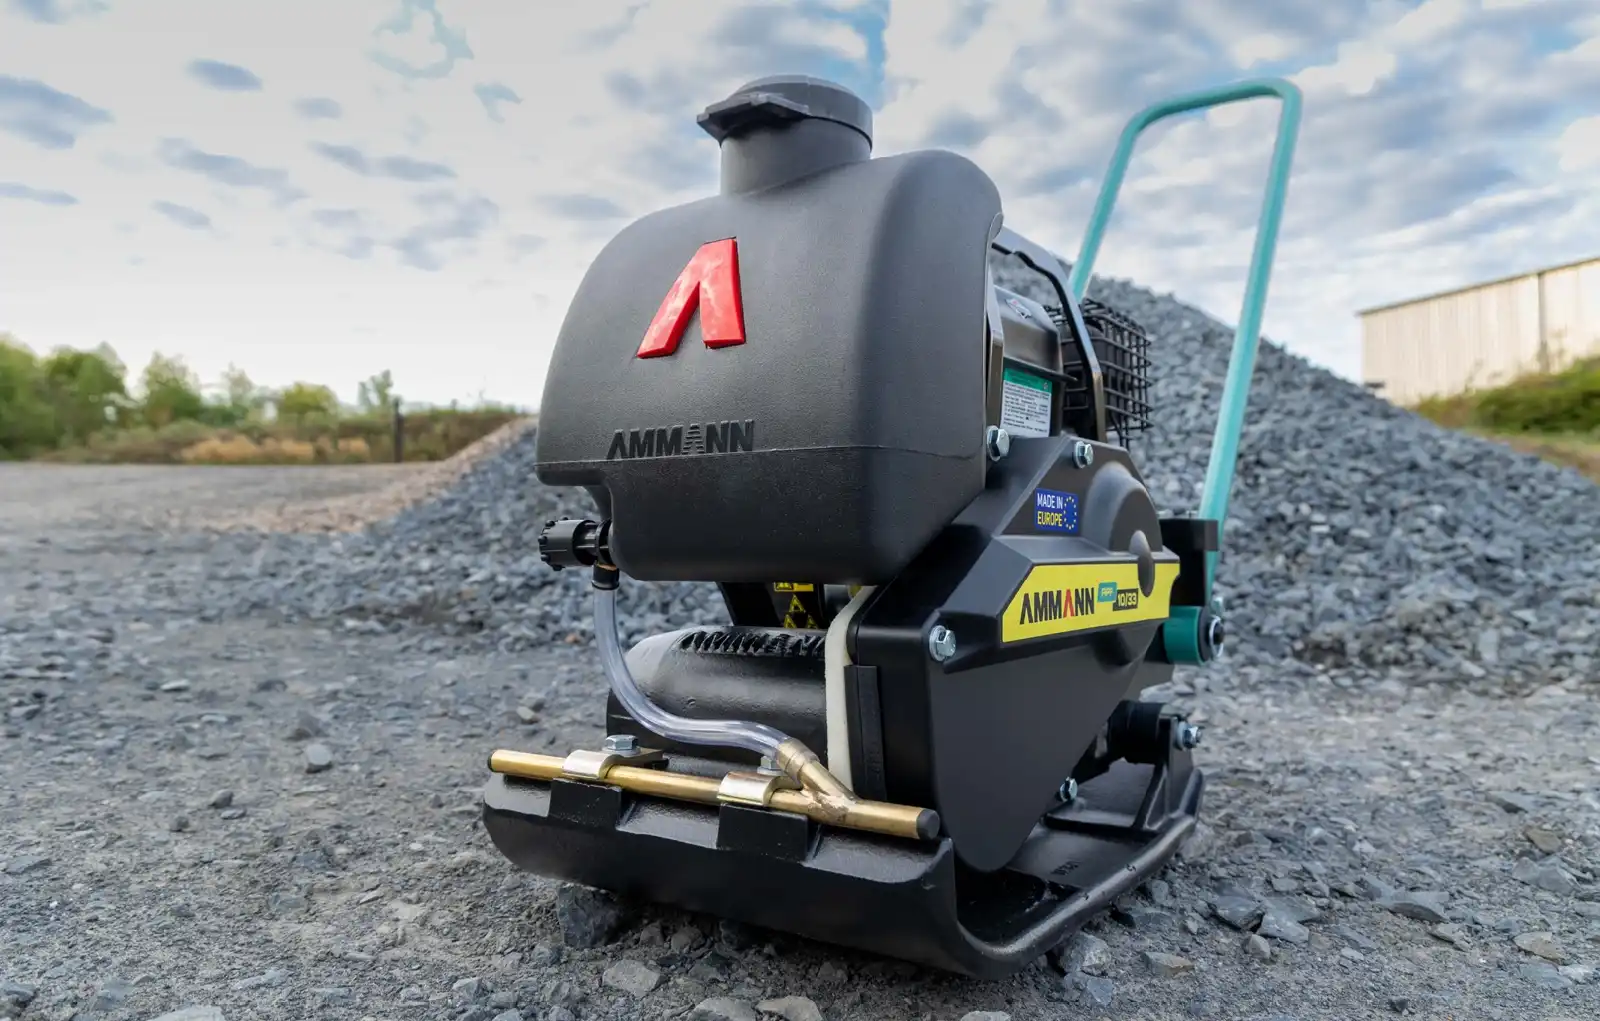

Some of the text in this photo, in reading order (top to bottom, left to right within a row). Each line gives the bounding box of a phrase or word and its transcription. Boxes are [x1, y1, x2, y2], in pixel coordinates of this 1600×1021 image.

[606, 419, 754, 460] AMMANN
[1037, 492, 1064, 510] MADE IN
[1037, 511, 1063, 527] EUROPE
[1019, 586, 1095, 625] AMMANN
[1117, 592, 1137, 607] 10/33
